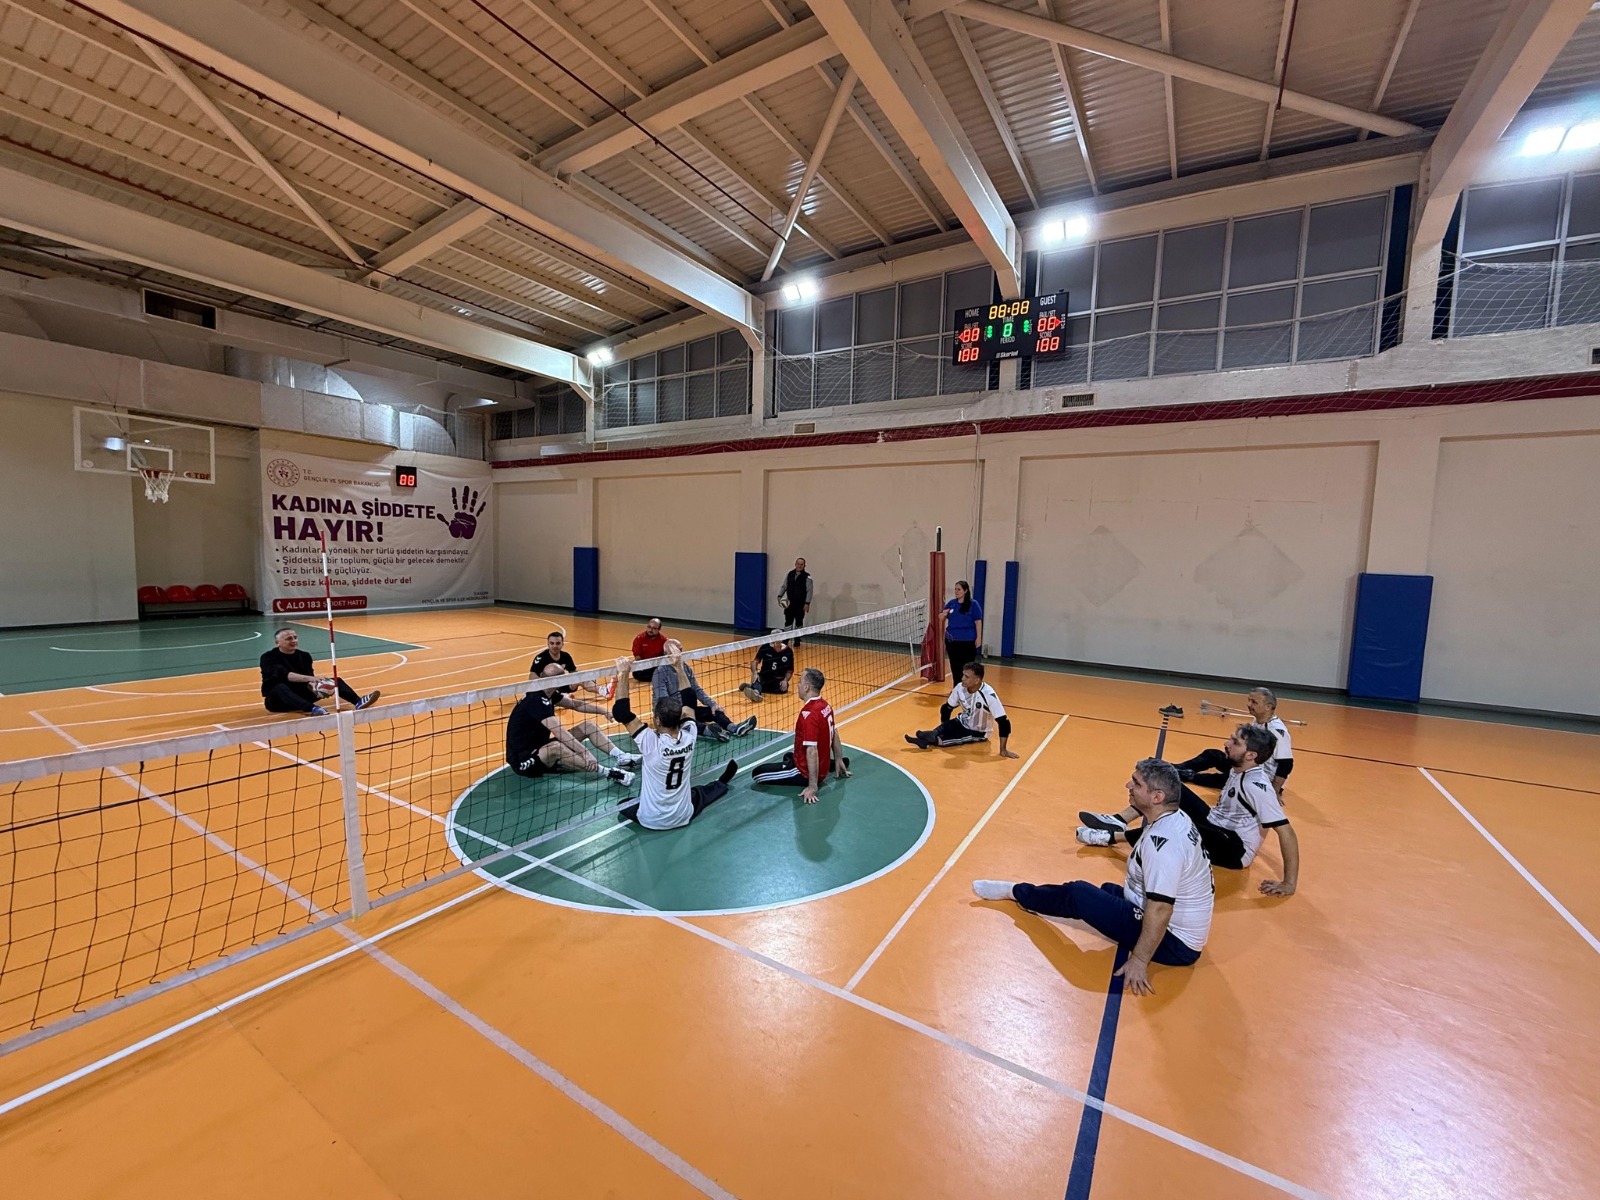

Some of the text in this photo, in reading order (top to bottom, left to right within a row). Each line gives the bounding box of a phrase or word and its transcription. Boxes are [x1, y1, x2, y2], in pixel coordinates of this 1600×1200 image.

[1040, 295, 1057, 306] GUEST
[965, 308, 980, 318] HOME
[1003, 323, 1013, 337] 8
[1000, 336, 1016, 344] PERIOD
[400, 474, 415, 486] 88
[272, 493, 436, 519] KADINA ŞİDDETE
[273, 516, 383, 542] HAYIR!
[282, 545, 325, 554] Kadınlar
[329, 547, 359, 556] yönelik
[376, 547, 395, 555] türlü
[396, 547, 424, 556] şiddetin
[327, 556, 337, 564] bir
[340, 556, 370, 566] toplum,
[373, 557, 394, 566] güçlü
[396, 556, 406, 564] bir
[408, 557, 434, 566] gelecek
[283, 566, 372, 576] Biz birlike güçlüyüz.
[283, 578, 316, 587] Sessiz
[352, 577, 382, 587] şiddete
[384, 577, 398, 585] dur
[400, 576, 412, 584] de!
[286, 601, 305, 609] ALO
[307, 600, 320, 608] 183
[771, 662, 778, 670] 5
[665, 756, 686, 790] 8
